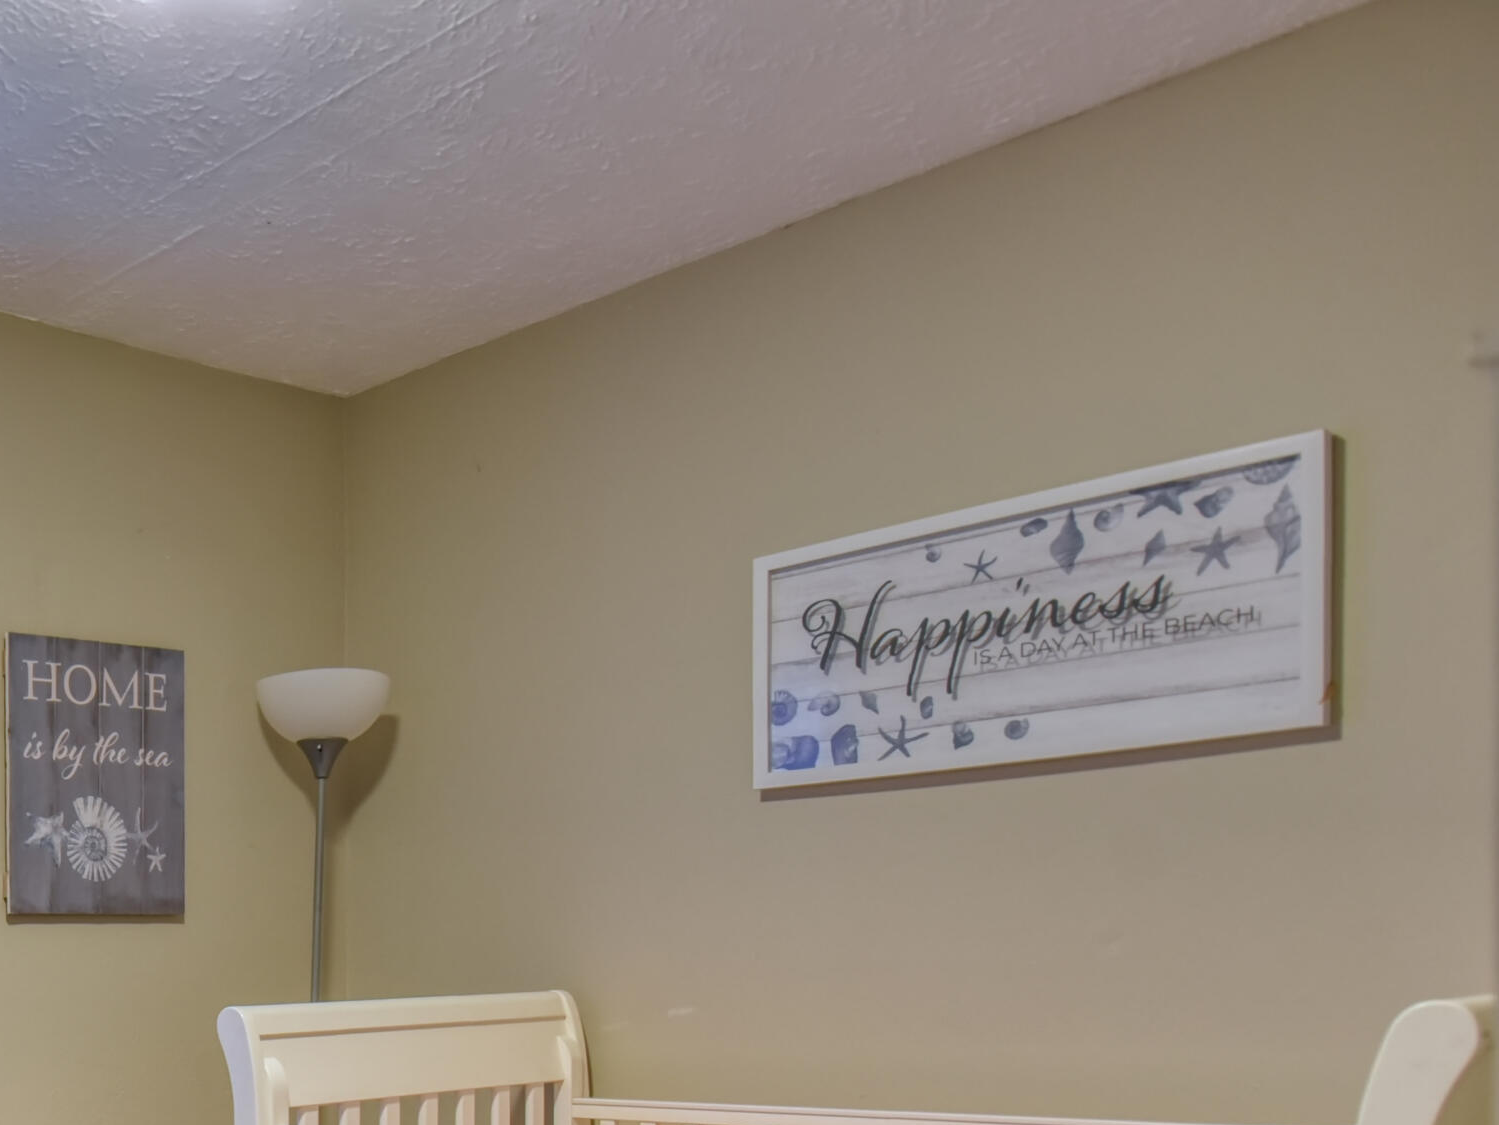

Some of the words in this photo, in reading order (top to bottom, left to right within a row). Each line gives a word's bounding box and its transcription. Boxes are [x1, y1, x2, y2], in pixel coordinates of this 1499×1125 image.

[802, 574, 1175, 698] Happiness
[973, 648, 993, 666] IS
[997, 645, 1013, 661] A
[1020, 636, 1066, 658] DAY
[1072, 630, 1102, 649] AT
[1107, 621, 1155, 643] THE
[1164, 605, 1255, 636] BEACH
[21, 659, 168, 712] HOME
[22, 731, 46, 761] is
[51, 728, 88, 781] by
[91, 731, 131, 766] the
[133, 746, 174, 768] sea
